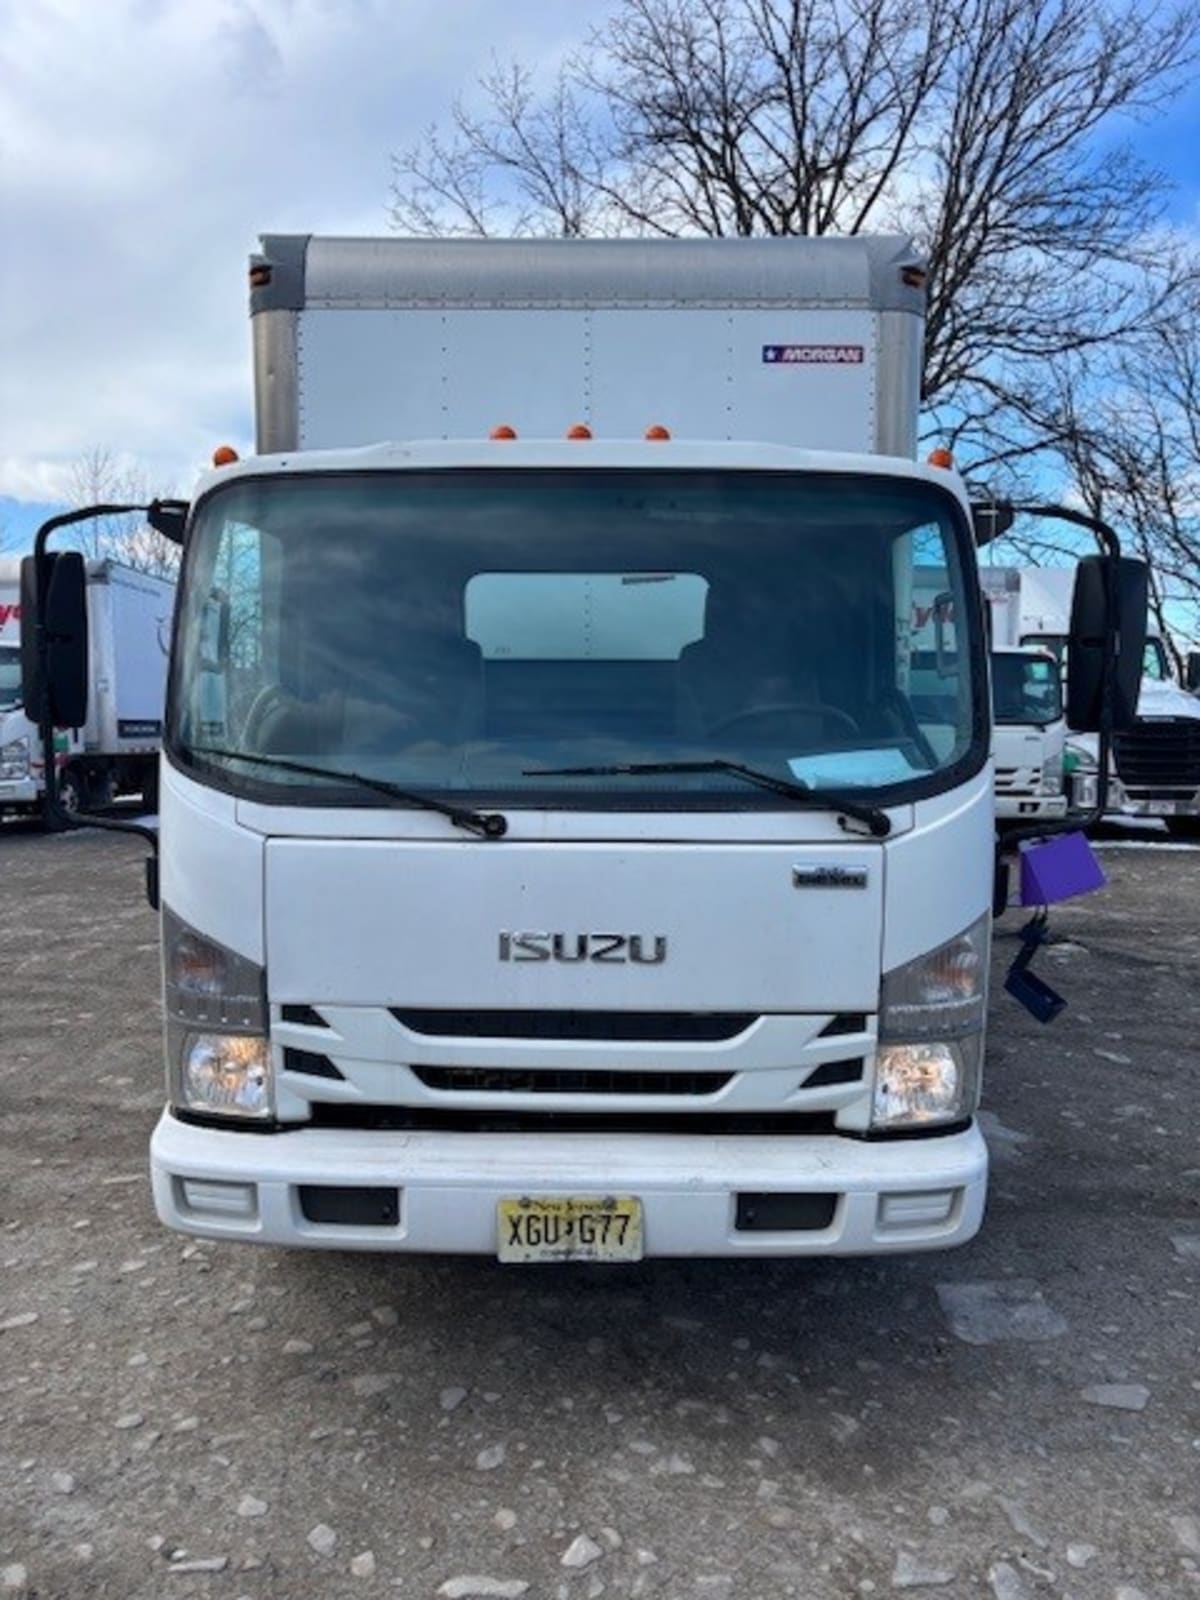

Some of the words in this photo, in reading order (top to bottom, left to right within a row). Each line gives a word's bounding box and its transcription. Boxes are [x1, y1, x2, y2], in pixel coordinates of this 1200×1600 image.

[782, 348, 860, 361] MORGAN
[499, 931, 667, 963] ISUZU
[508, 1213, 559, 1246] XGU
[579, 1213, 632, 1246] G77
